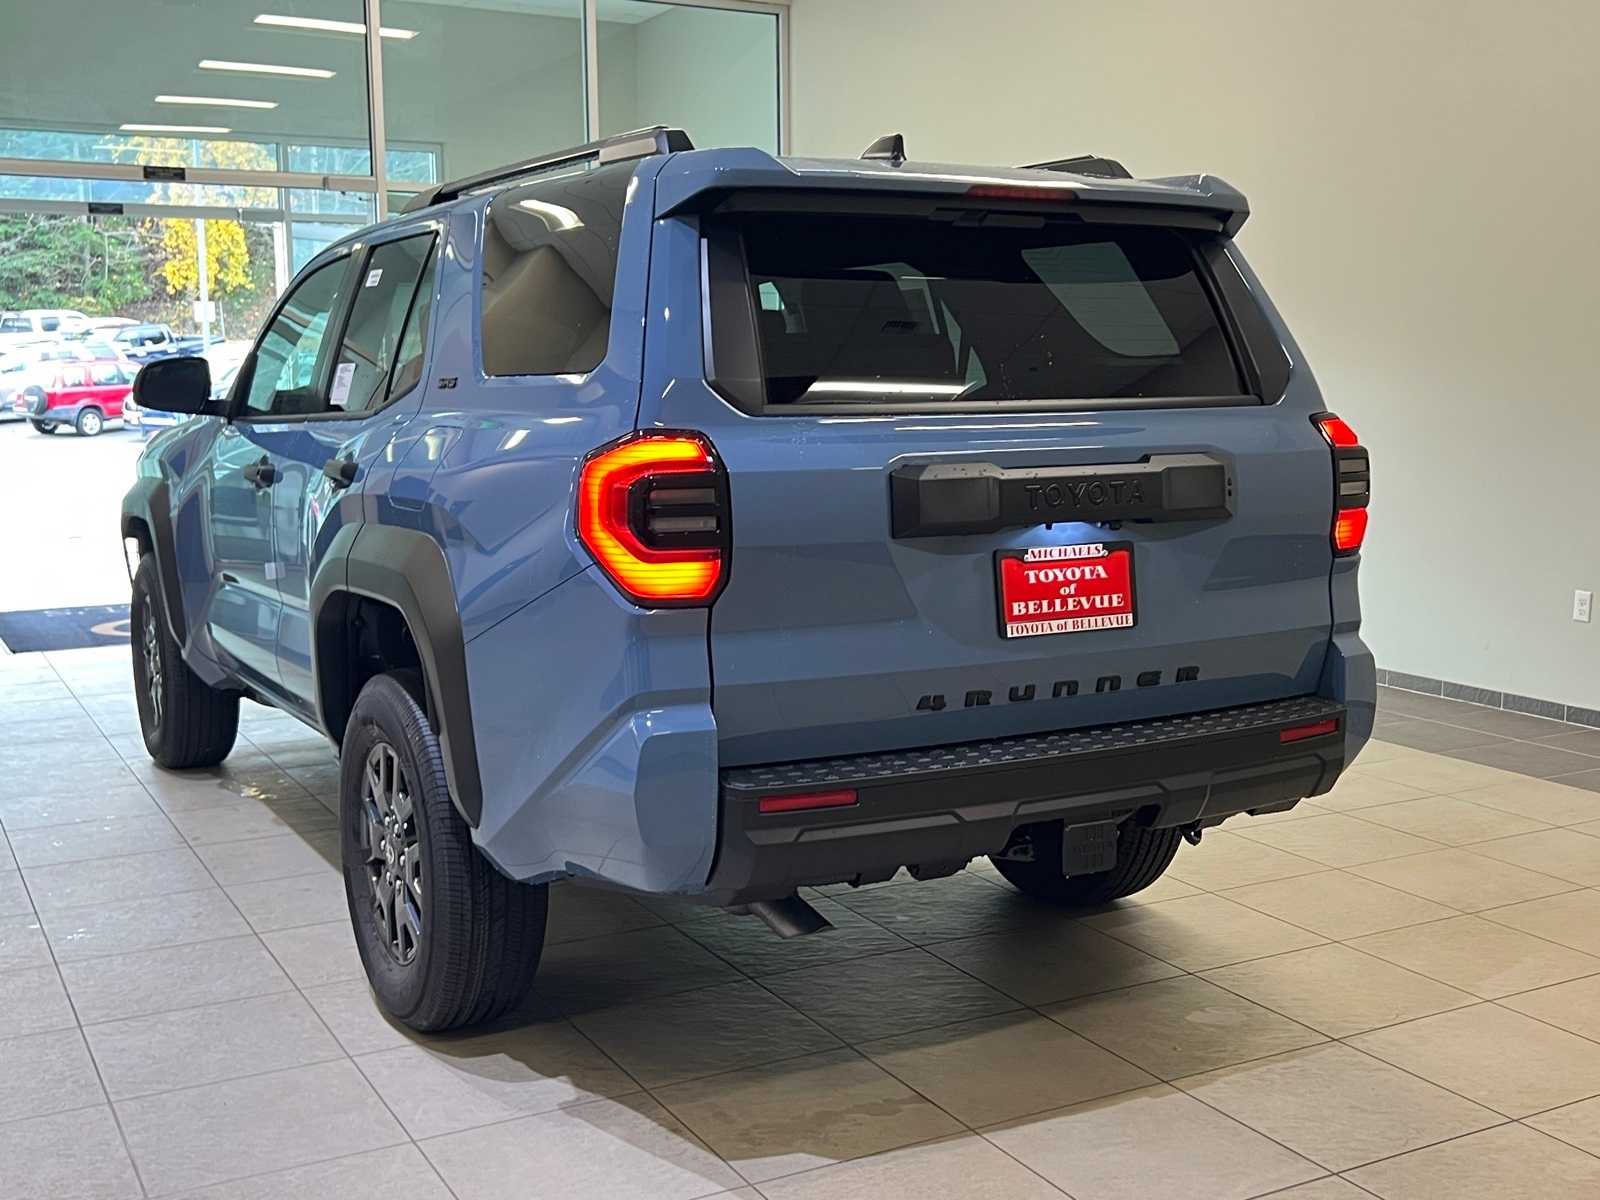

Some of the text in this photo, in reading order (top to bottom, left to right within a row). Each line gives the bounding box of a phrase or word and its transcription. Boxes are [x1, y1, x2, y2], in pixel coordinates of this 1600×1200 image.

[1024, 480, 1144, 510] TOYOTA
[1029, 546, 1102, 559] MICHAELS
[1024, 565, 1108, 583] TOYOTA
[1059, 583, 1077, 595] of
[1012, 594, 1124, 616] BELLEVUE
[1009, 615, 1131, 636] TOYOTA of BELLEVUE
